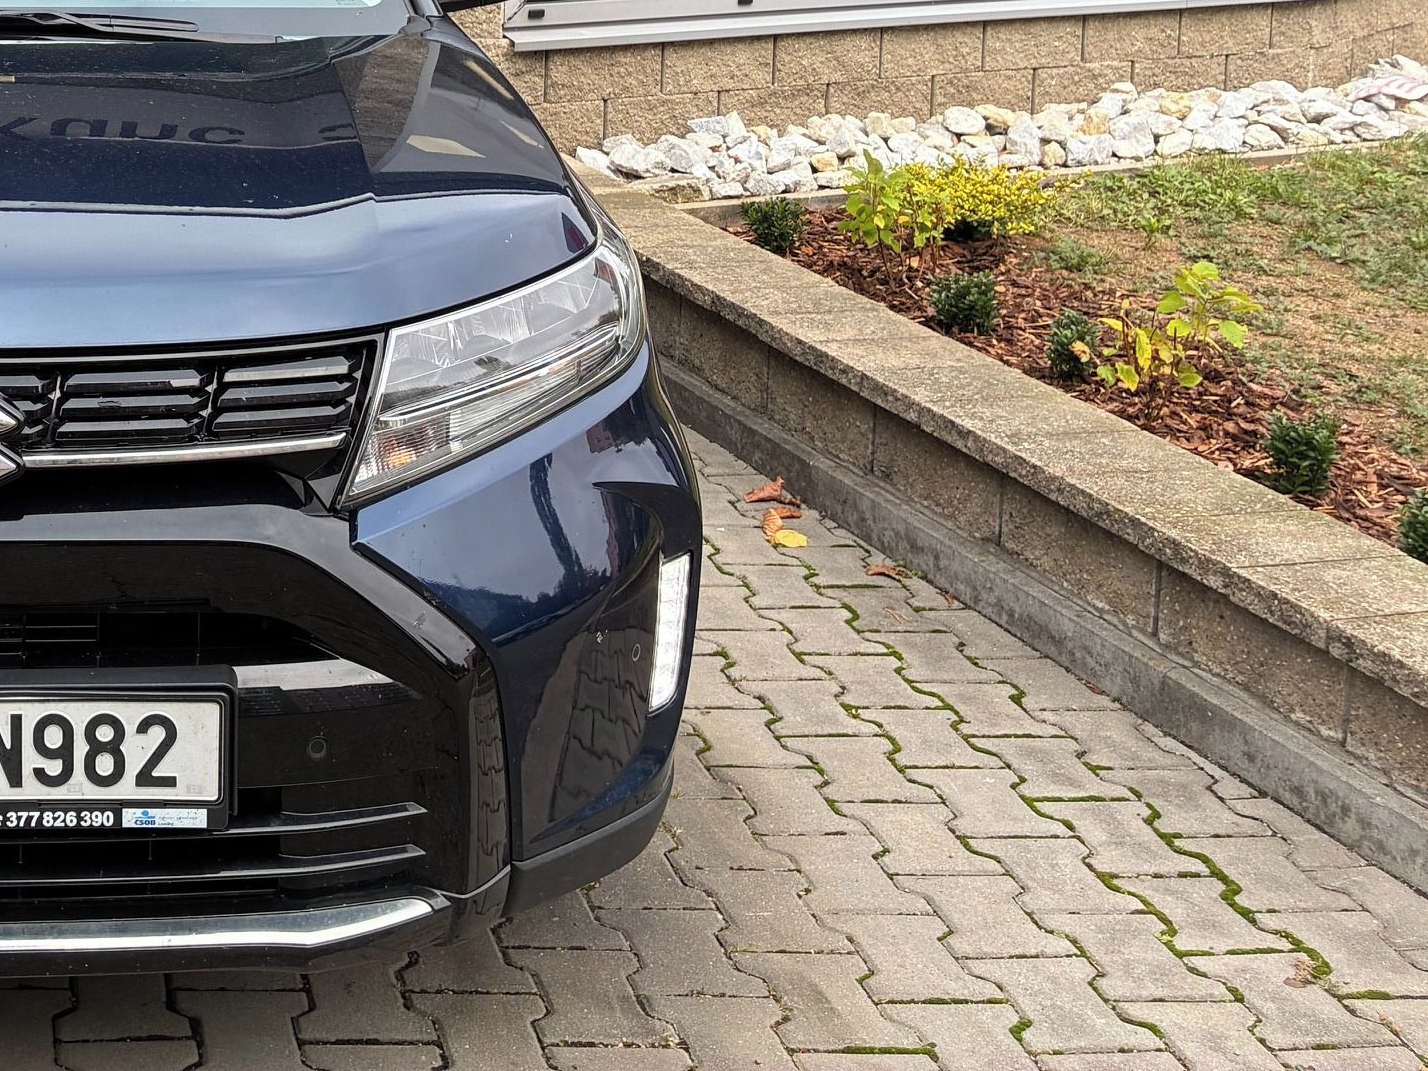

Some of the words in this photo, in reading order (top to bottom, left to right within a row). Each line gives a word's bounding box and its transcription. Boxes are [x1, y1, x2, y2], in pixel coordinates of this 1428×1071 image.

[5, 811, 42, 827] 377
[43, 811, 77, 827] 826
[80, 811, 114, 827] 390
